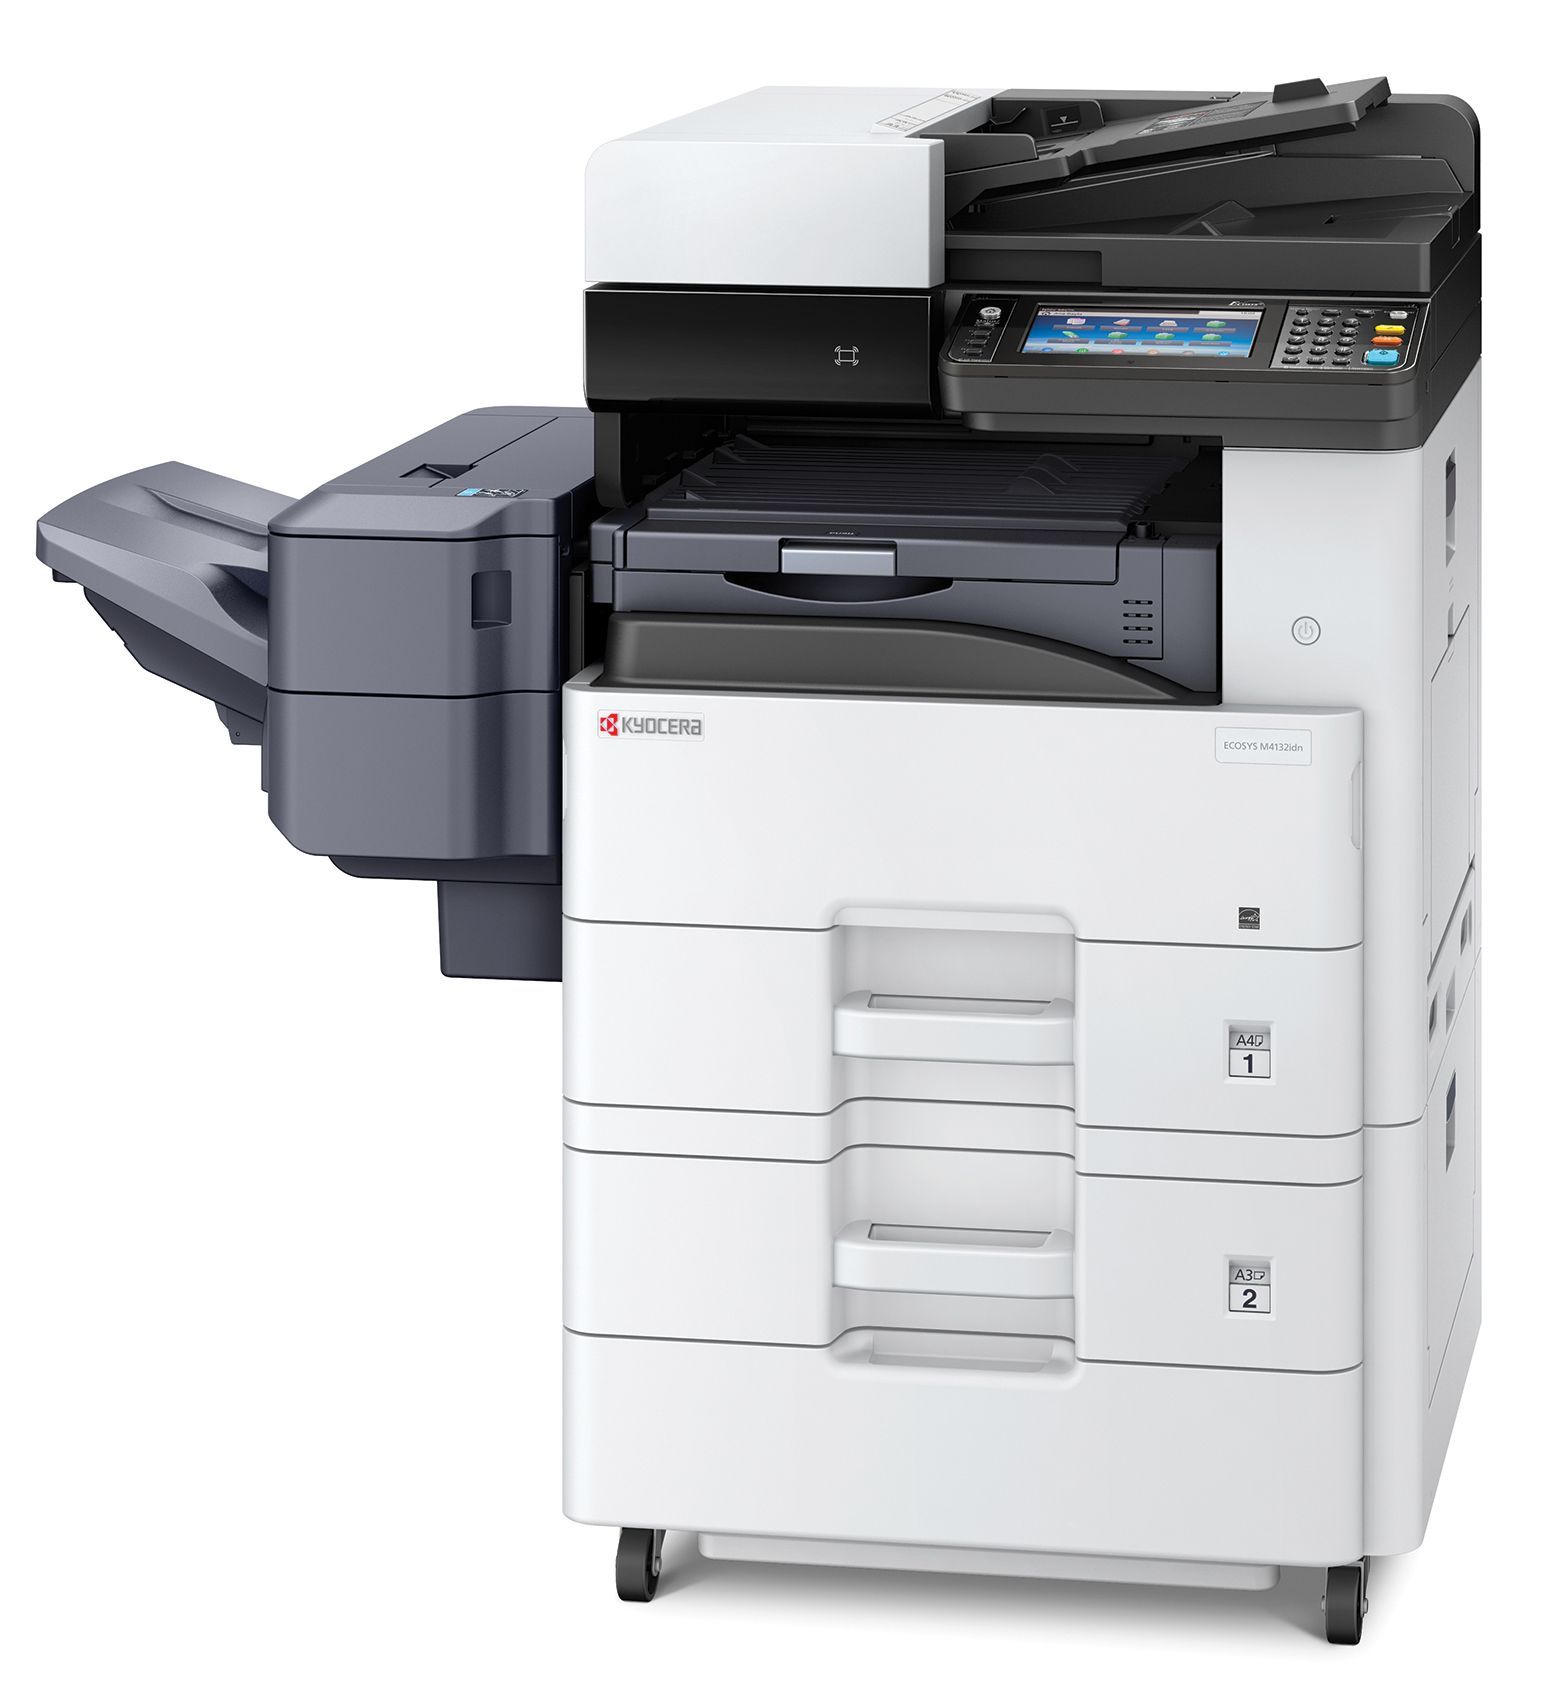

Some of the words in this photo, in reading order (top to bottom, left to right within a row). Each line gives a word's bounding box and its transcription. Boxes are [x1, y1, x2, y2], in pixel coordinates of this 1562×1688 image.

[621, 716, 702, 736] KYOCERA
[1223, 741, 1258, 751] ECOSYS
[1259, 742, 1304, 752] M4132idn
[1236, 1034, 1254, 1046] A4
[1243, 1053, 1253, 1074] 1
[1235, 1268, 1253, 1281] A3
[1242, 1288, 1257, 1309] 2
